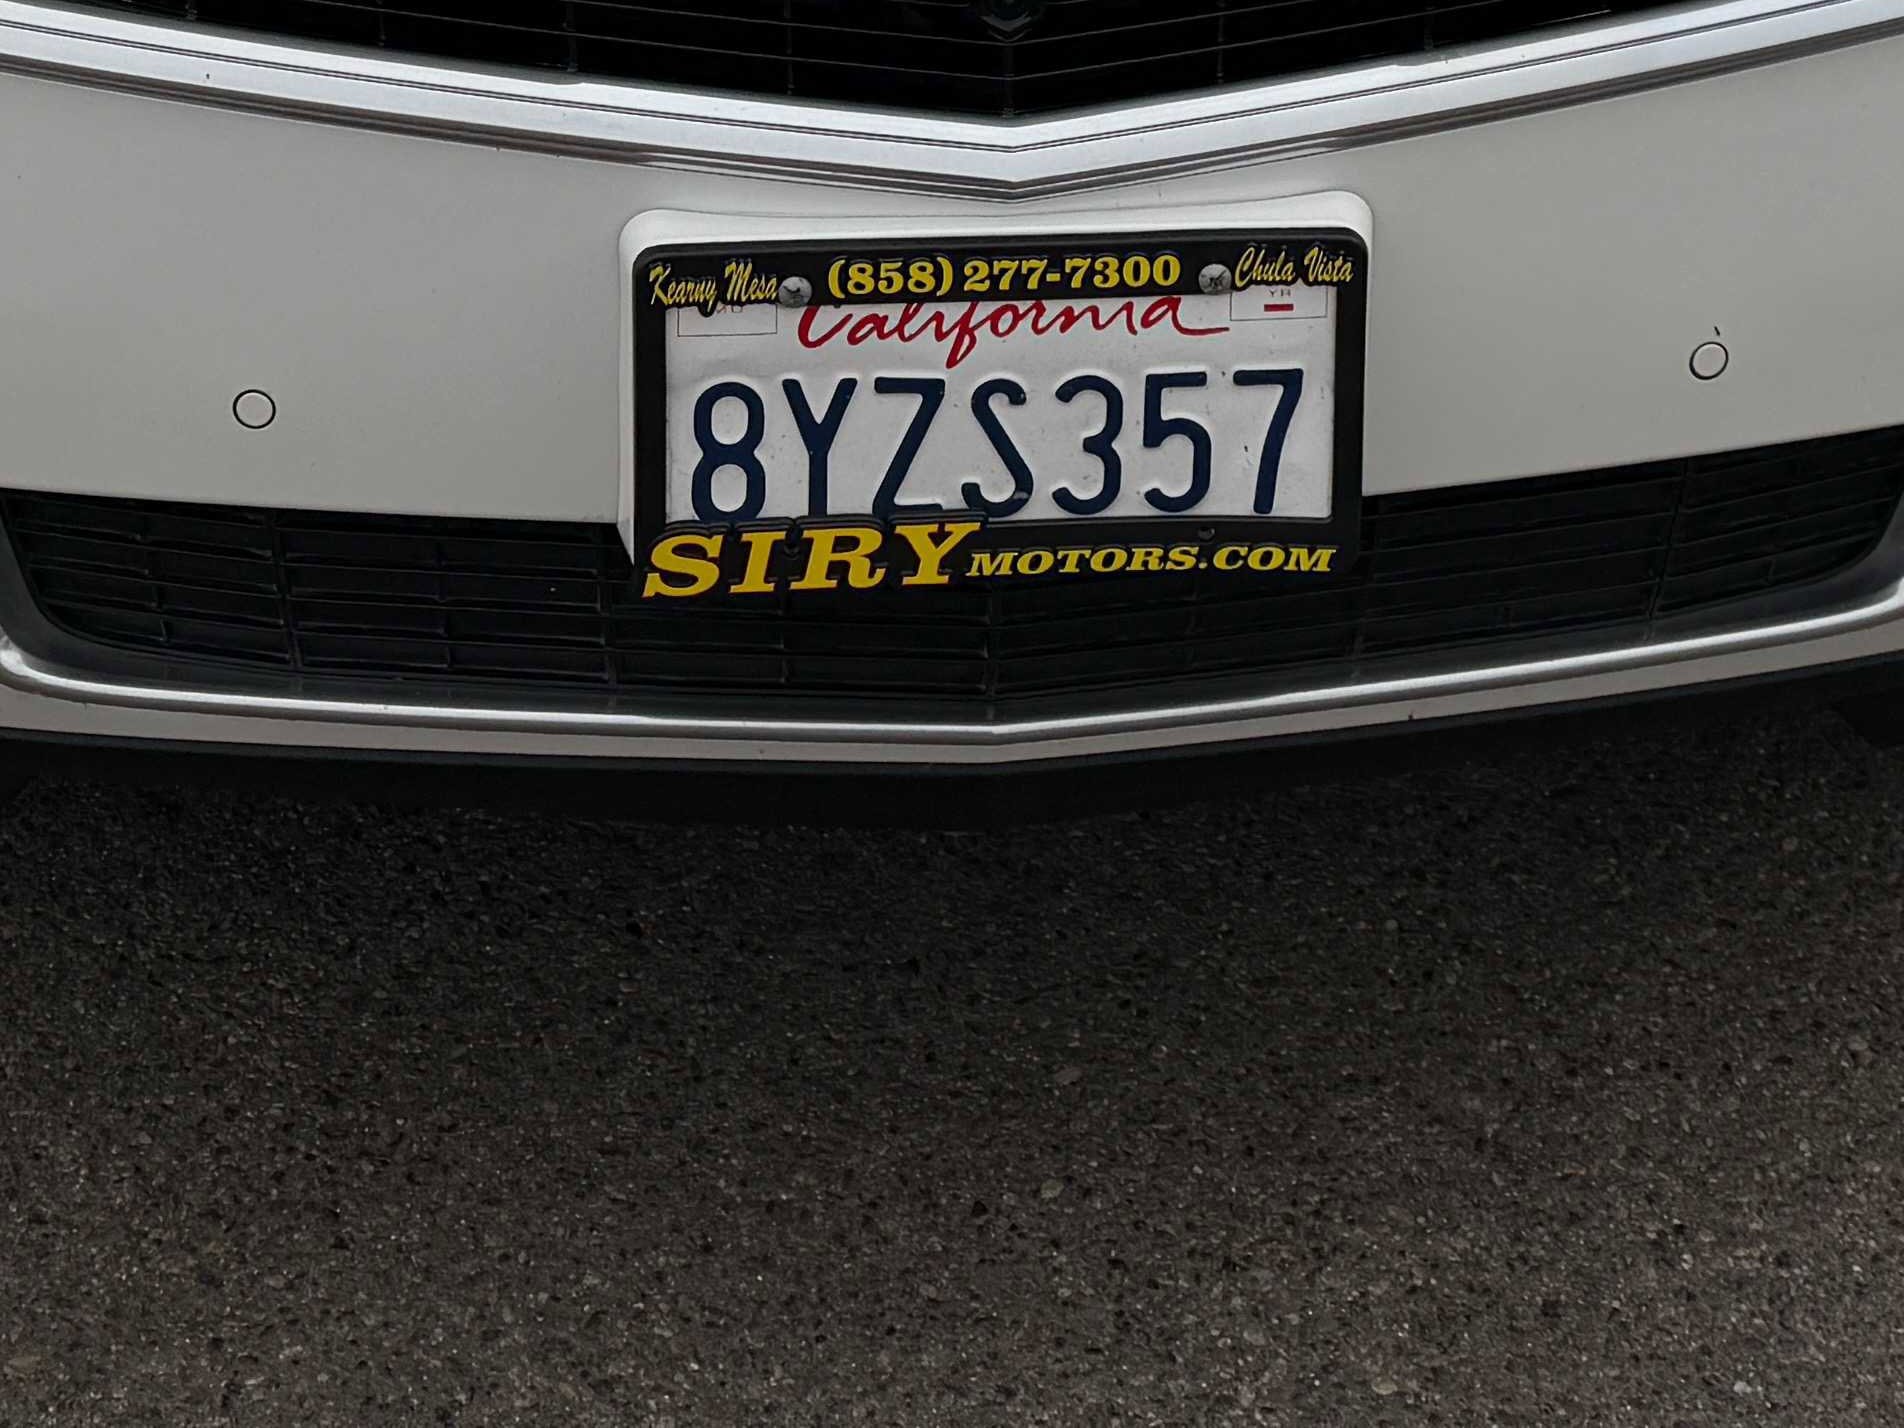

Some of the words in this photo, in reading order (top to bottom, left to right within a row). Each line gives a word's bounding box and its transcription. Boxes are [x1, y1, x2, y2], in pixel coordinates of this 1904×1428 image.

[648, 264, 718, 307] Kearny
[724, 261, 779, 302] Mesa
[827, 257, 954, 299] (858)
[963, 253, 1182, 293] 277-7300
[1234, 247, 1296, 288] Chula
[1303, 246, 1353, 284] Vista
[797, 296, 1231, 369] California
[690, 367, 1304, 522] 8YZS357
[641, 522, 981, 598] SIRY
[965, 544, 1336, 578] MOTORS.COM
